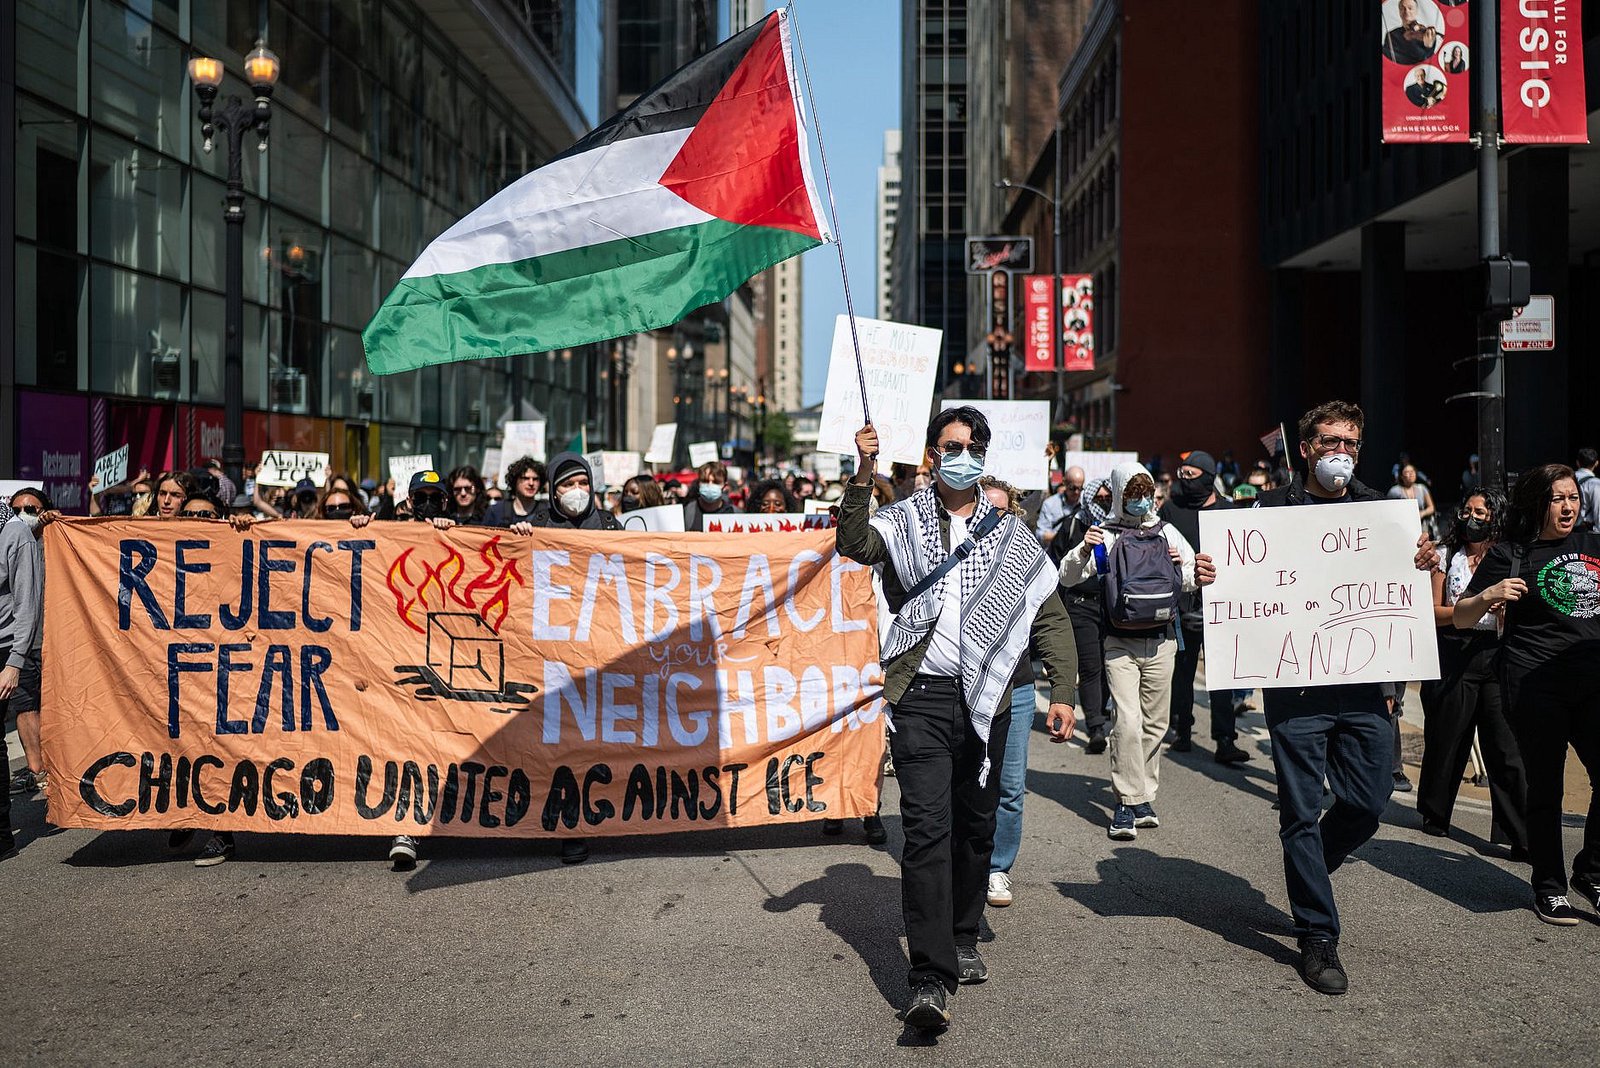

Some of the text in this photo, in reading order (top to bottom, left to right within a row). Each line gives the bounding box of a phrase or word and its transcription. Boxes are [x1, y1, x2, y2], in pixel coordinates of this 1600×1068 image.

[1554, 30, 1567, 65] FOR
[1036, 306, 1050, 360] MUSIC
[1506, 340, 1549, 348] TOW ZONE
[855, 367, 909, 394] IMIGRANTS
[200, 420, 225, 458] Resta
[825, 415, 917, 462] 192
[96, 447, 128, 473] ABOLISH
[103, 468, 118, 488] ICE
[263, 451, 323, 470] Abolish
[1227, 526, 1369, 566] NO ONE
[118, 539, 377, 632] REJECT
[532, 549, 868, 645] EMBRACE
[1276, 570, 1297, 587] IS
[1209, 601, 1289, 625] ILLEGAL
[1329, 581, 1413, 616] STOLEN
[167, 643, 340, 739] FEAR
[542, 660, 884, 750] NEIGHBORS
[79, 751, 827, 832] CHICAGO UNITED AGAINST ICE
